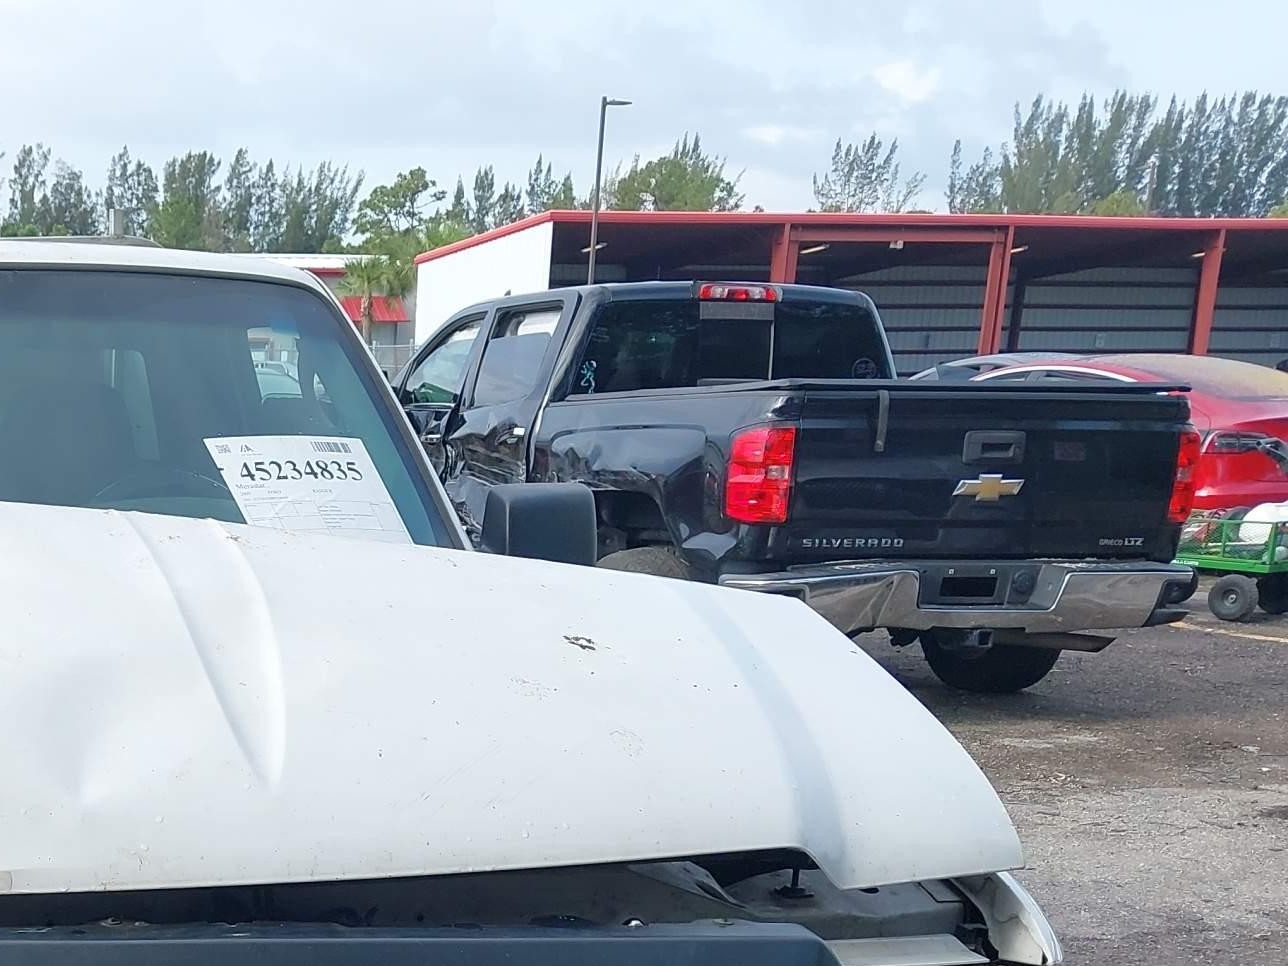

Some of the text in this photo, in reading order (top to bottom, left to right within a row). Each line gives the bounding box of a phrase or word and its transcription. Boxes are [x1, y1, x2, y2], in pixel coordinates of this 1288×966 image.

[240, 460, 363, 481] 45234835
[802, 538, 905, 548] SILVERADO
[1124, 537, 1144, 546] LTZ
